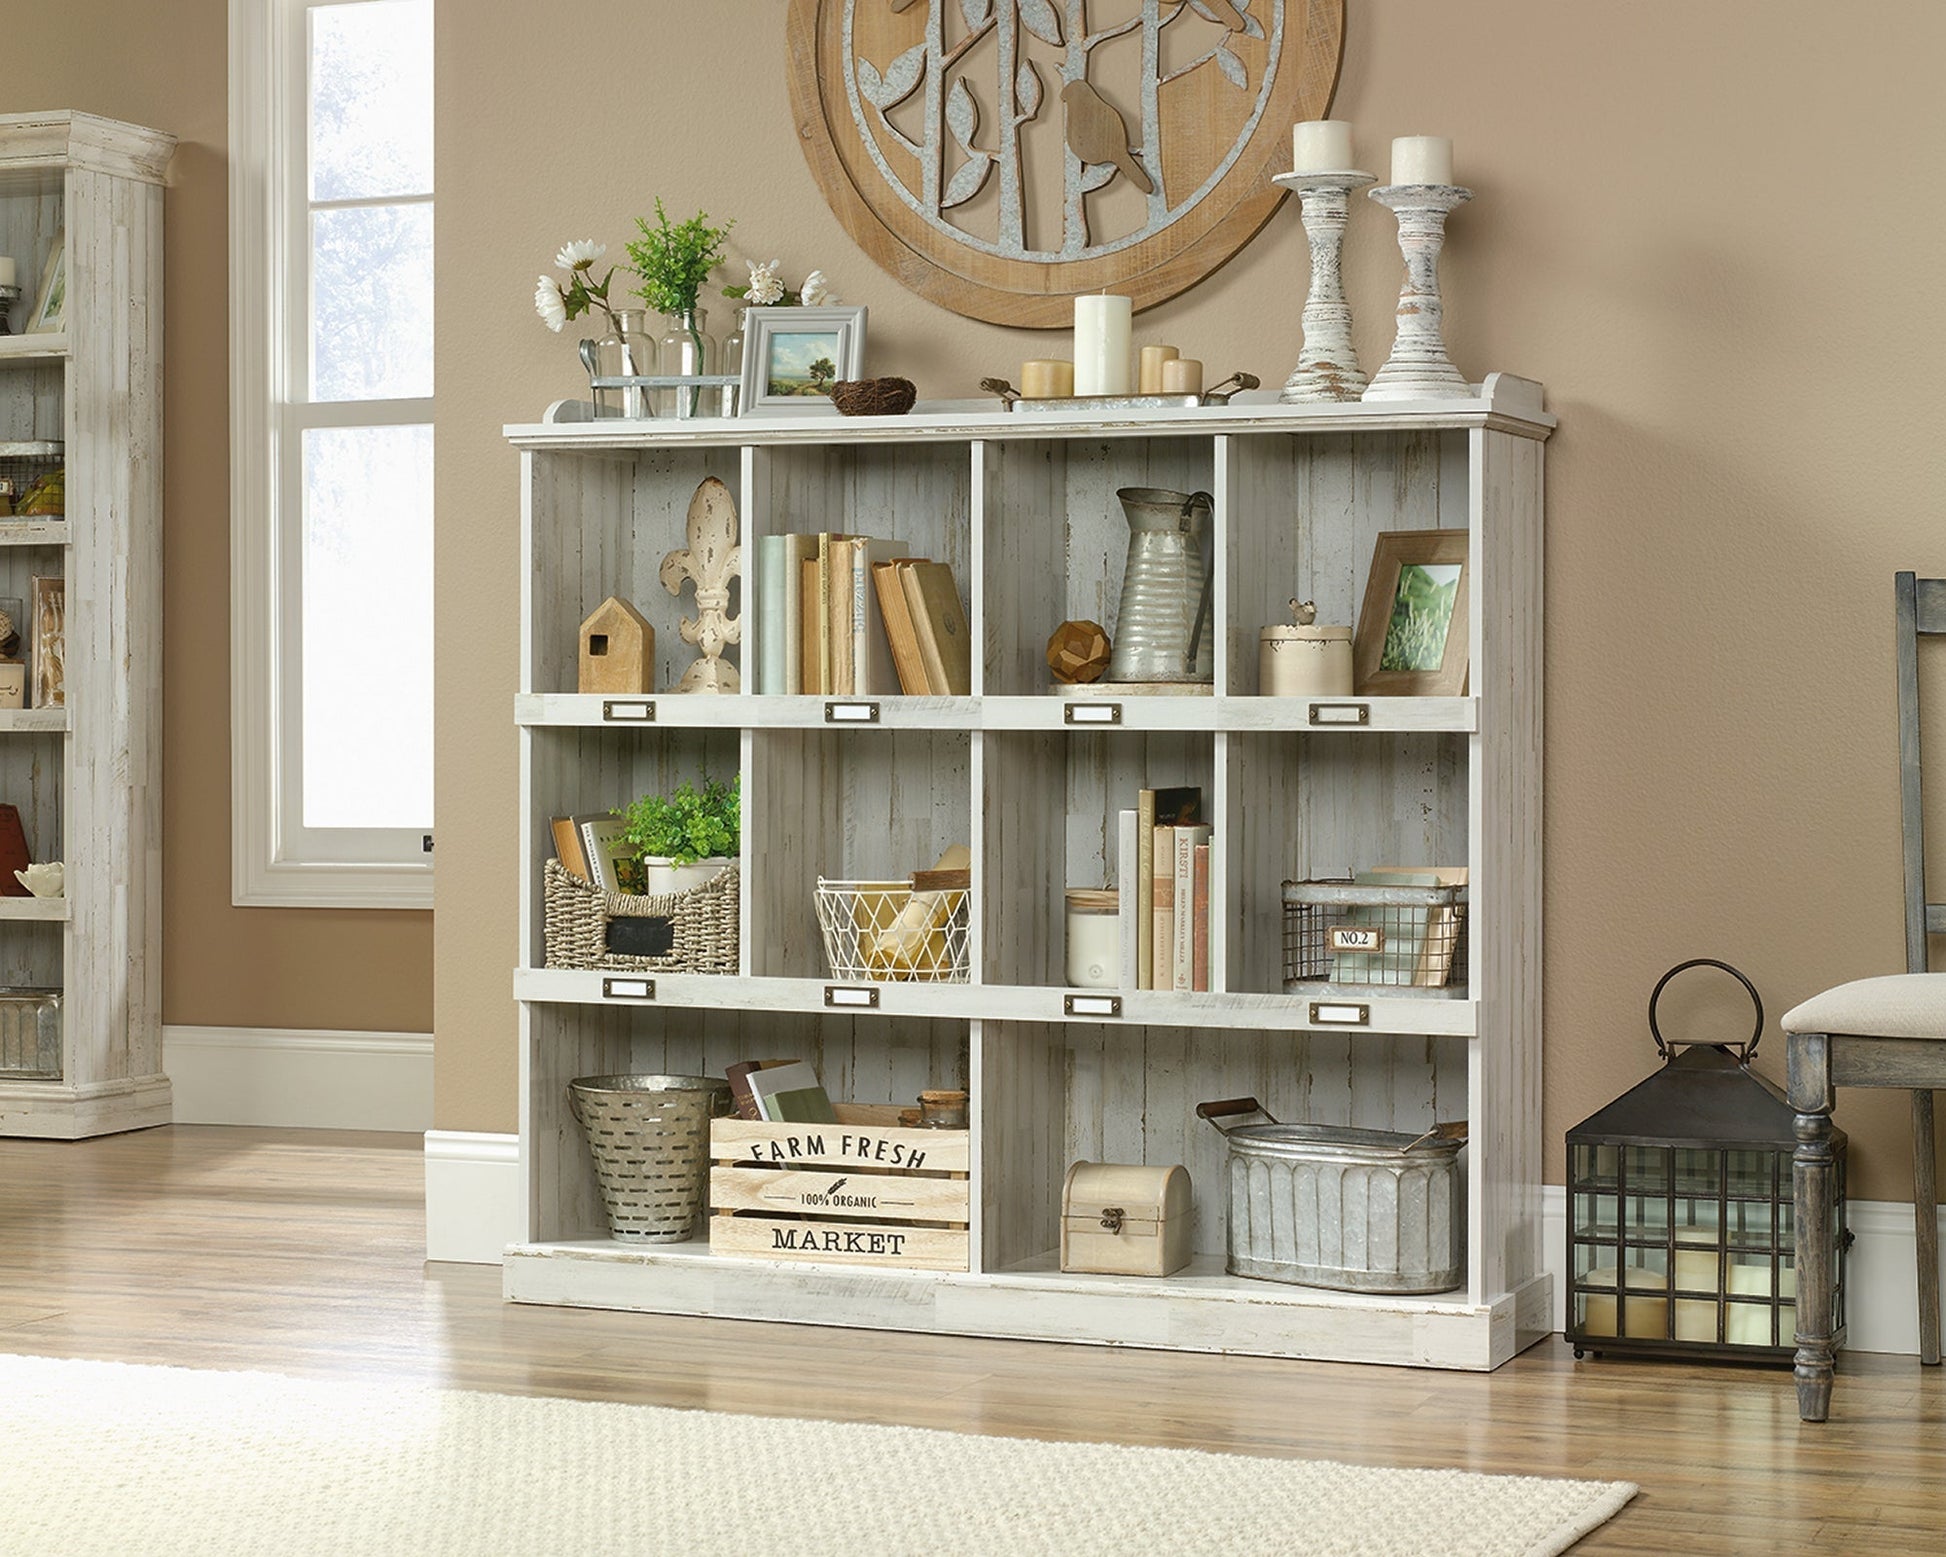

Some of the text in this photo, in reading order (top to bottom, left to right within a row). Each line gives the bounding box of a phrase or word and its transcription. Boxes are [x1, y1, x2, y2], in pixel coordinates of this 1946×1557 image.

[1179, 838, 1188, 879] KIRSTI
[1340, 932, 1368, 945] NO.2
[750, 1134, 926, 1168] FARM FRESH
[801, 1193, 877, 1208] 100% ORGANIC
[772, 1228, 905, 1255] MARKET
